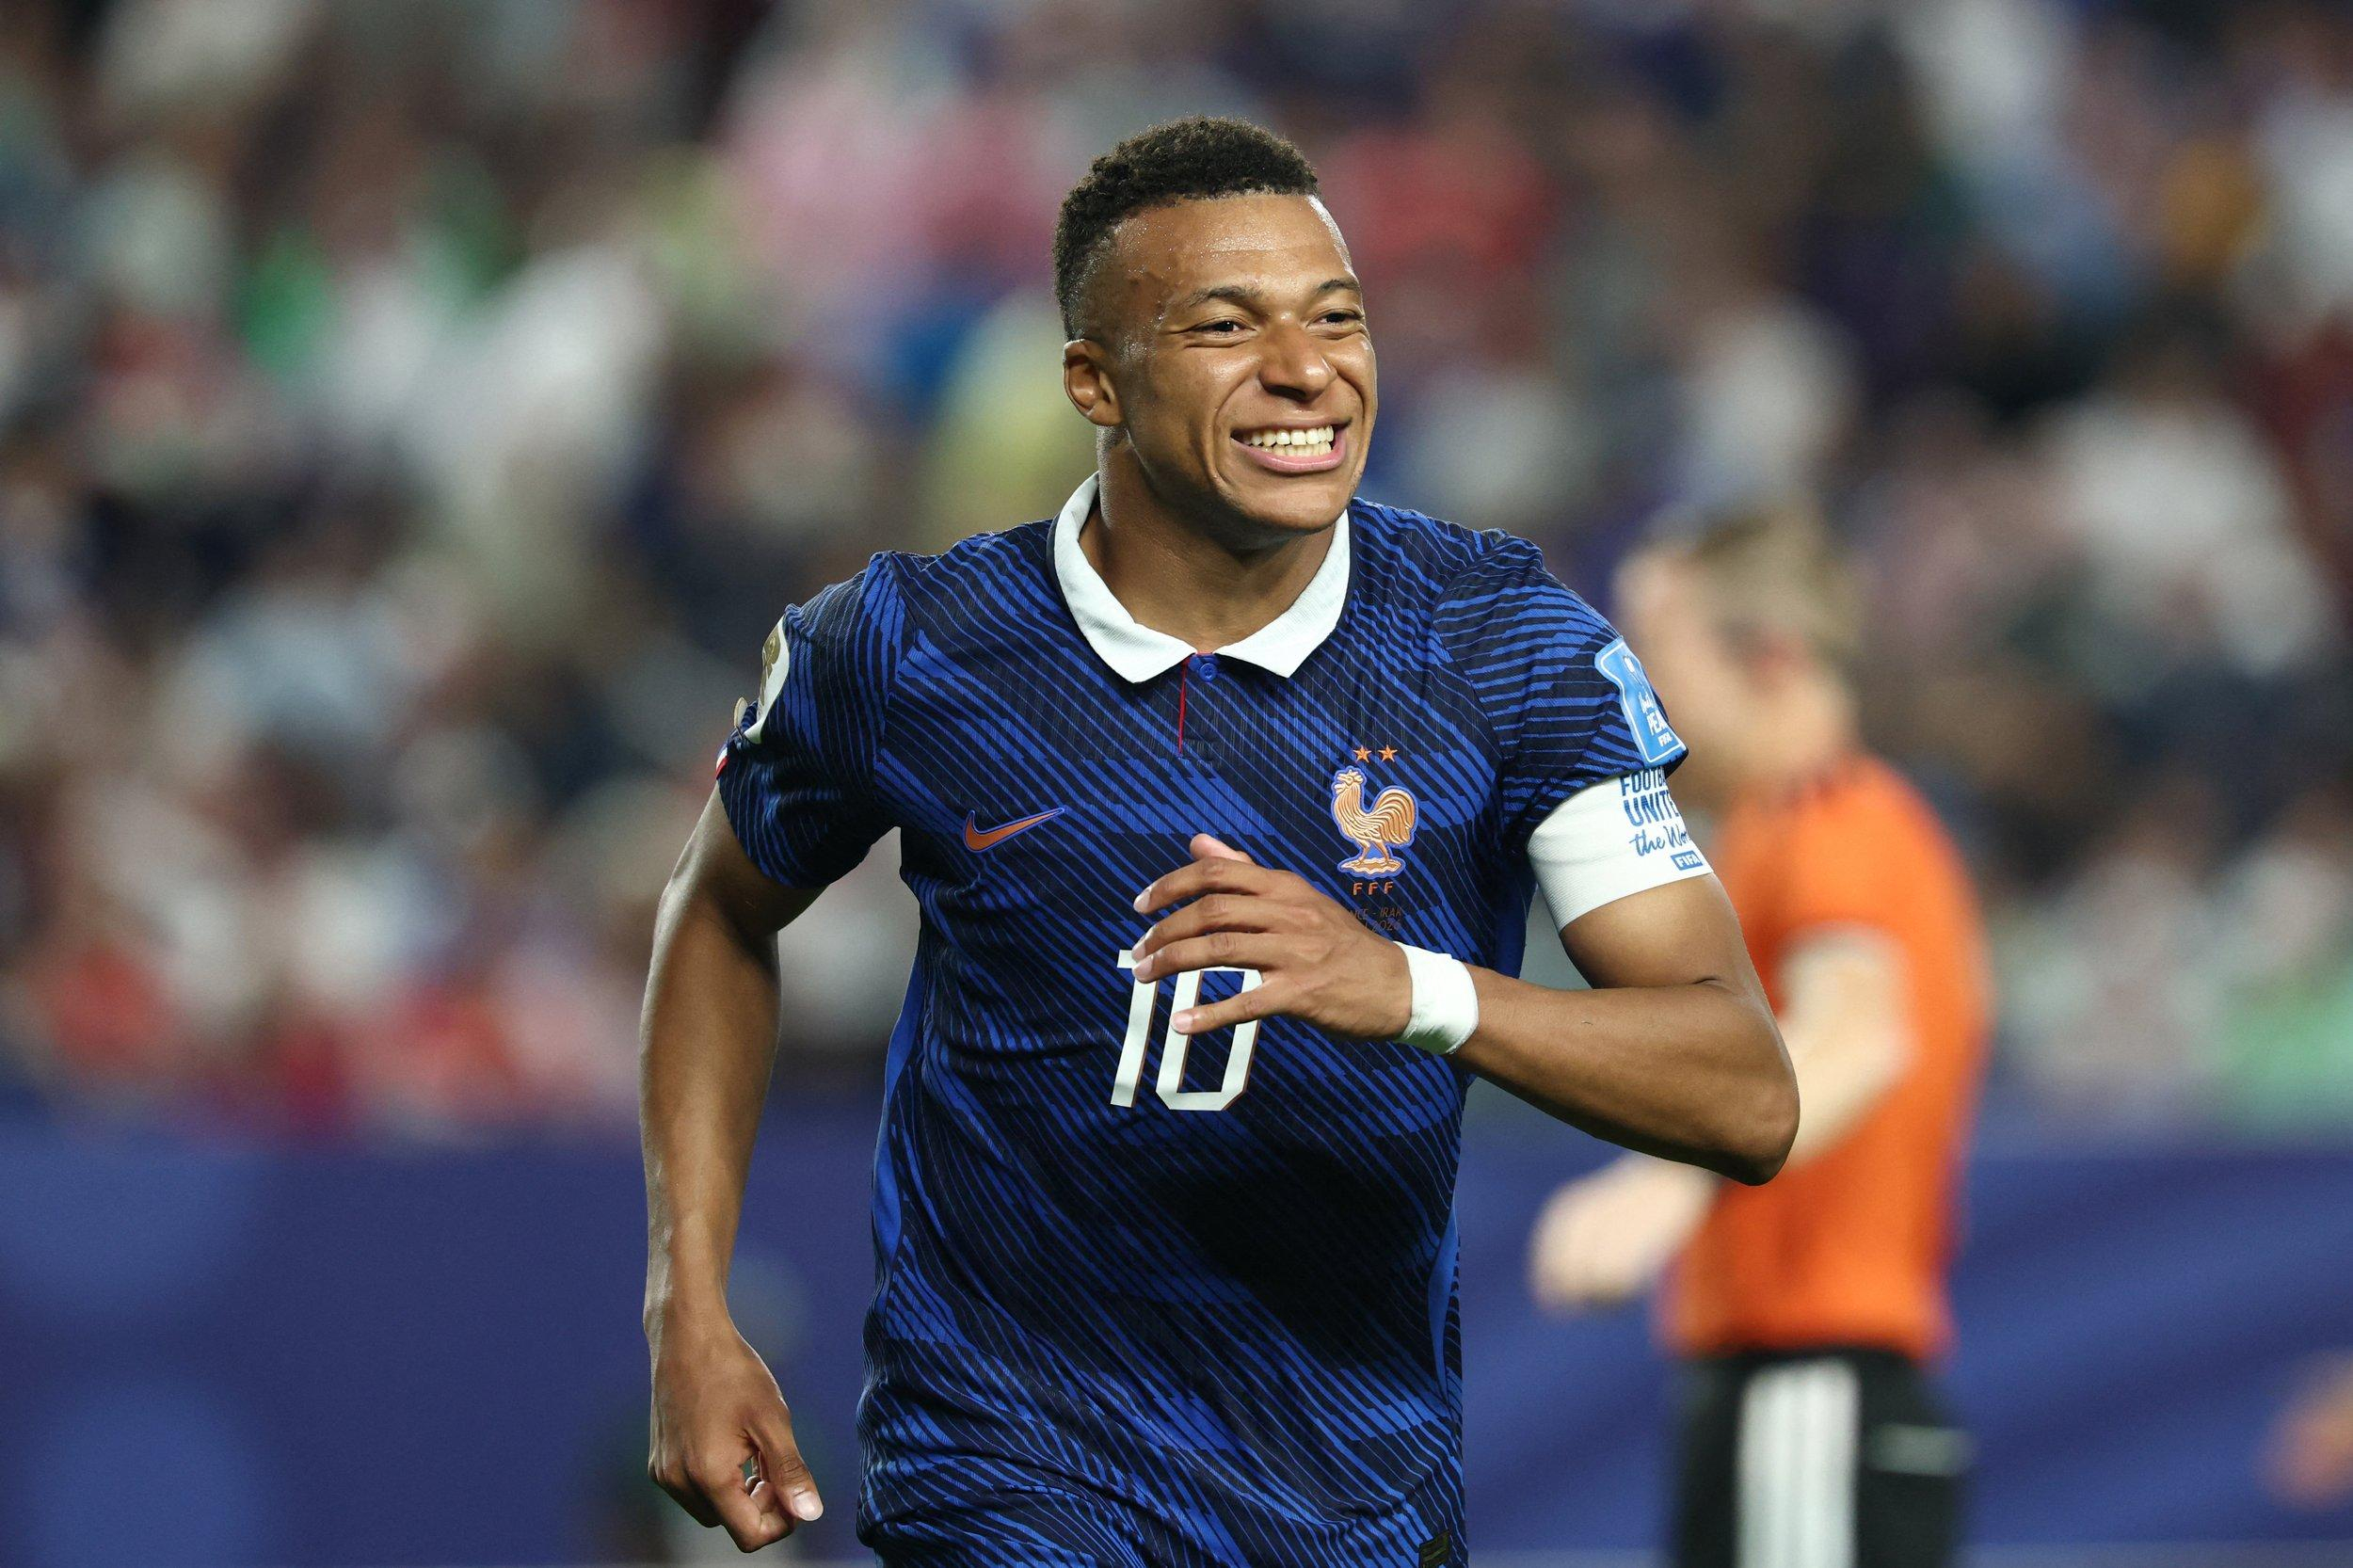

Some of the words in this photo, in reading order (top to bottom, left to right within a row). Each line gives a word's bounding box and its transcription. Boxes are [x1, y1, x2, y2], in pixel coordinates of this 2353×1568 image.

[1646, 710, 1668, 736] PEA
[1620, 766, 1666, 796] FOOTB
[1624, 790, 1679, 826] UNITE
[1629, 829, 1665, 856] the
[1674, 853, 1701, 868] FIFA
[1353, 881, 1394, 895] FFF
[1111, 950, 1263, 1111] 10
